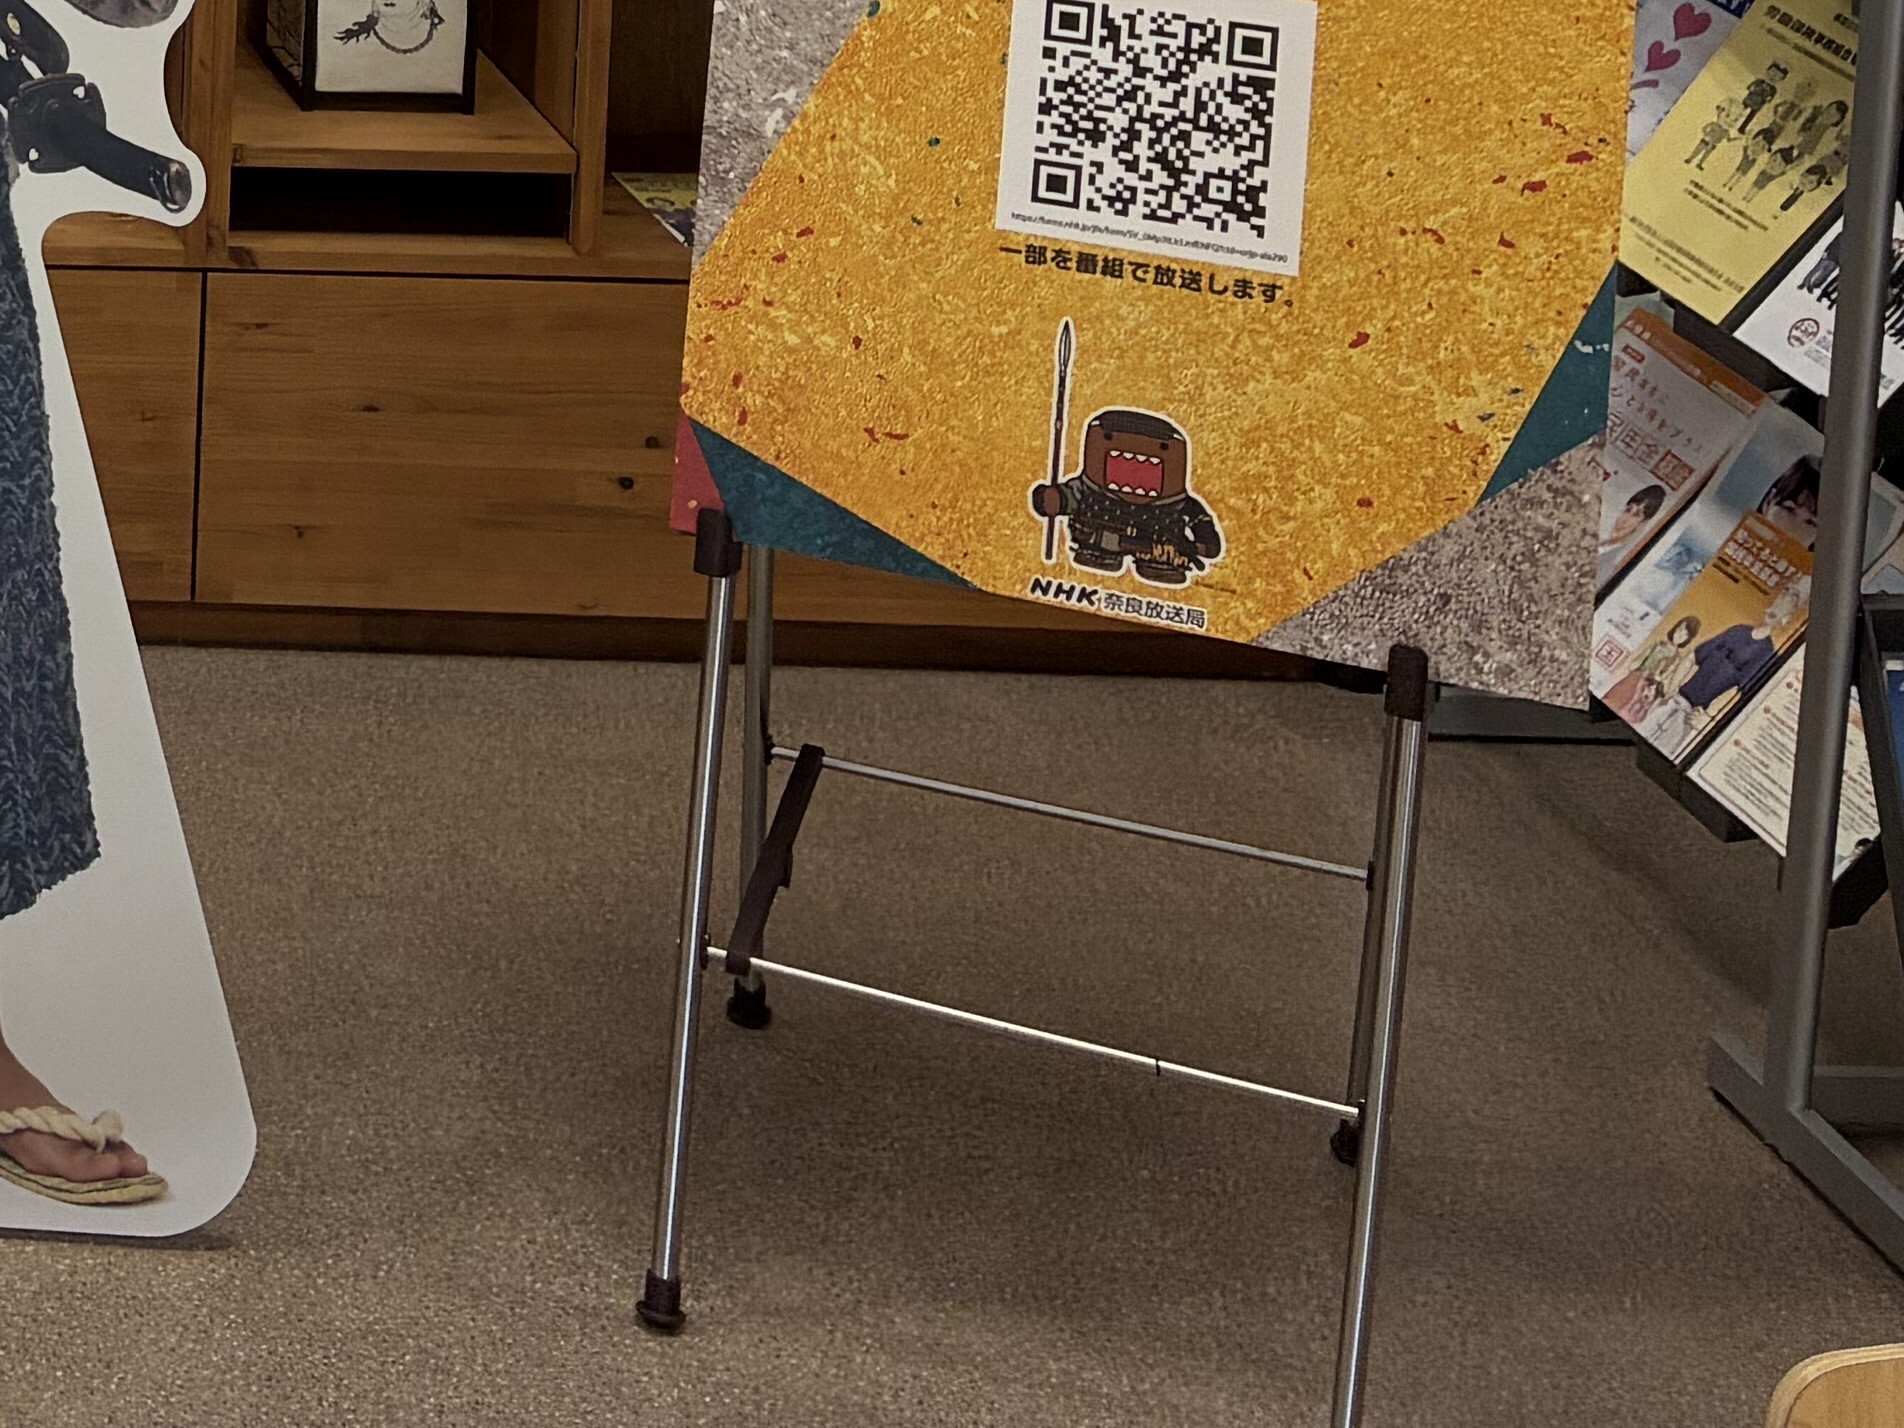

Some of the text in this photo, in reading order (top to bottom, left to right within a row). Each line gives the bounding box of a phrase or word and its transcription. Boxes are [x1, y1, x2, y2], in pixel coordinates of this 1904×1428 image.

[999, 243, 1294, 308] 一部を番組で放送します。
[1029, 574, 1206, 629] NHK 奈良放送局
